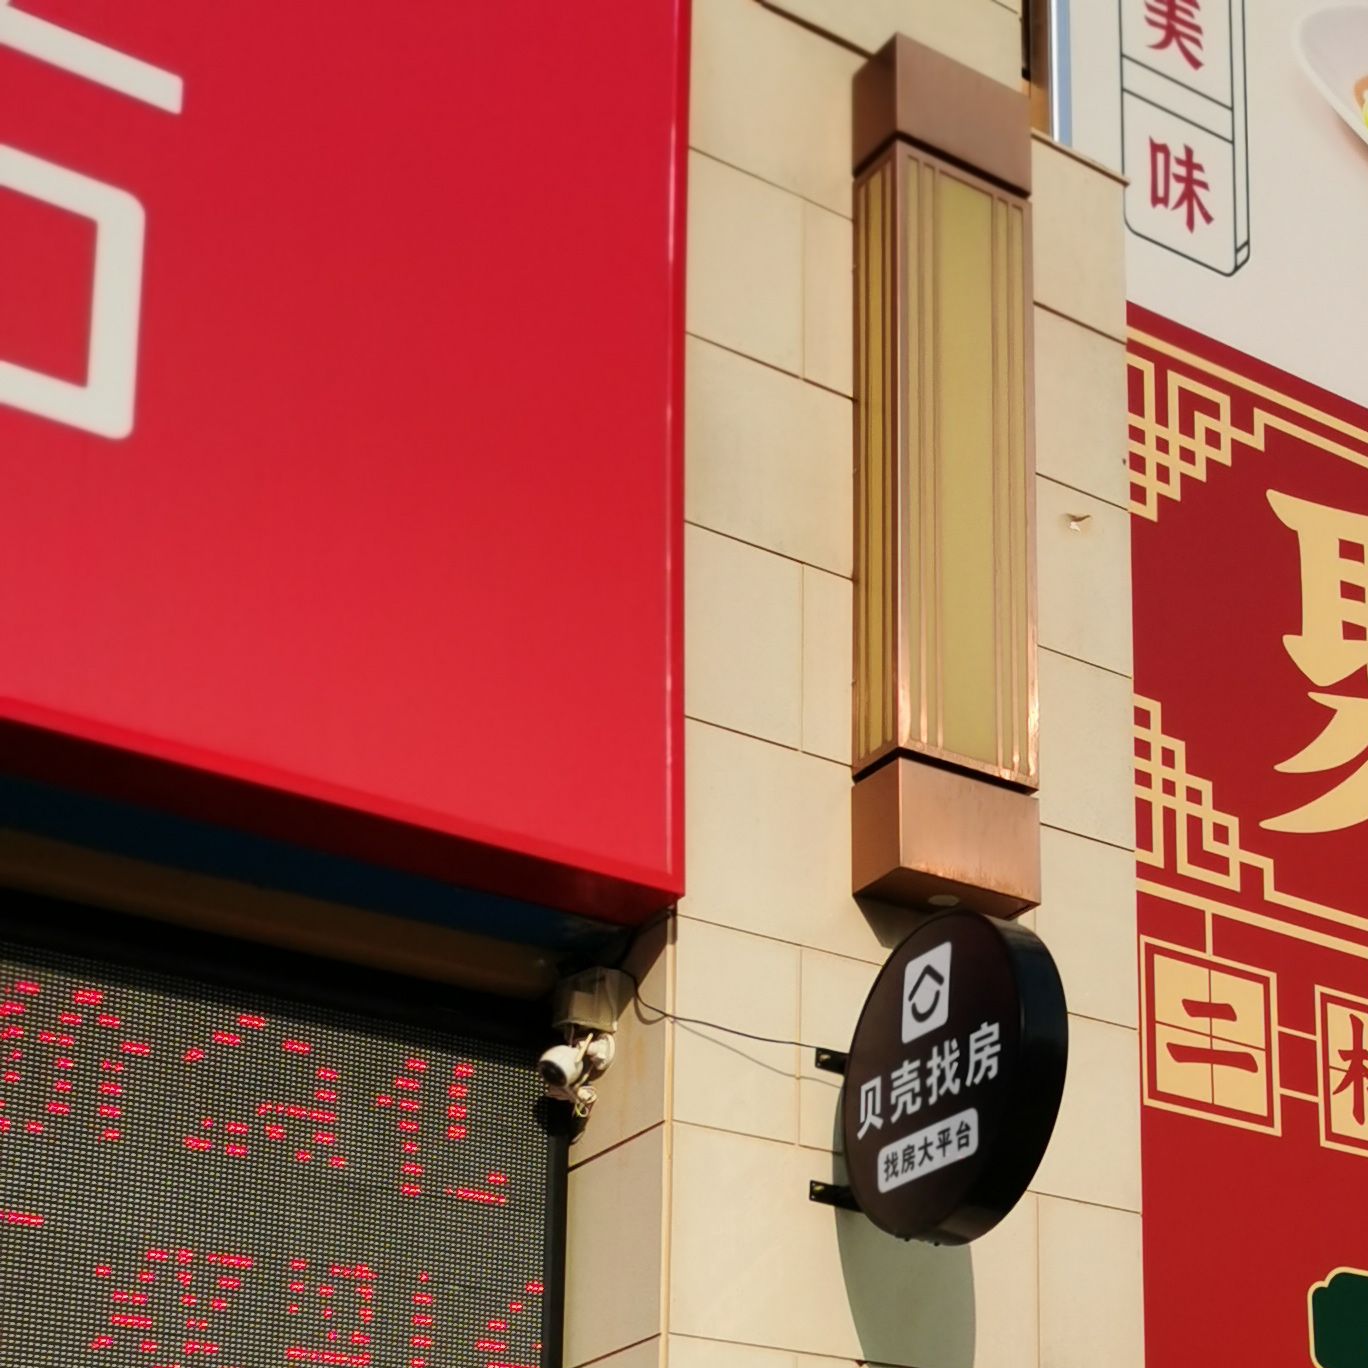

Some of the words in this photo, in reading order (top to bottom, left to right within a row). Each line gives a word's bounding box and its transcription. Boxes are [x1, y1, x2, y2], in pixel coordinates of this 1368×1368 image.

[1144, 0, 1214, 234] 美味
[857, 1021, 1001, 1140] 贝壳找房
[884, 1120, 971, 1182] 找房大平台
